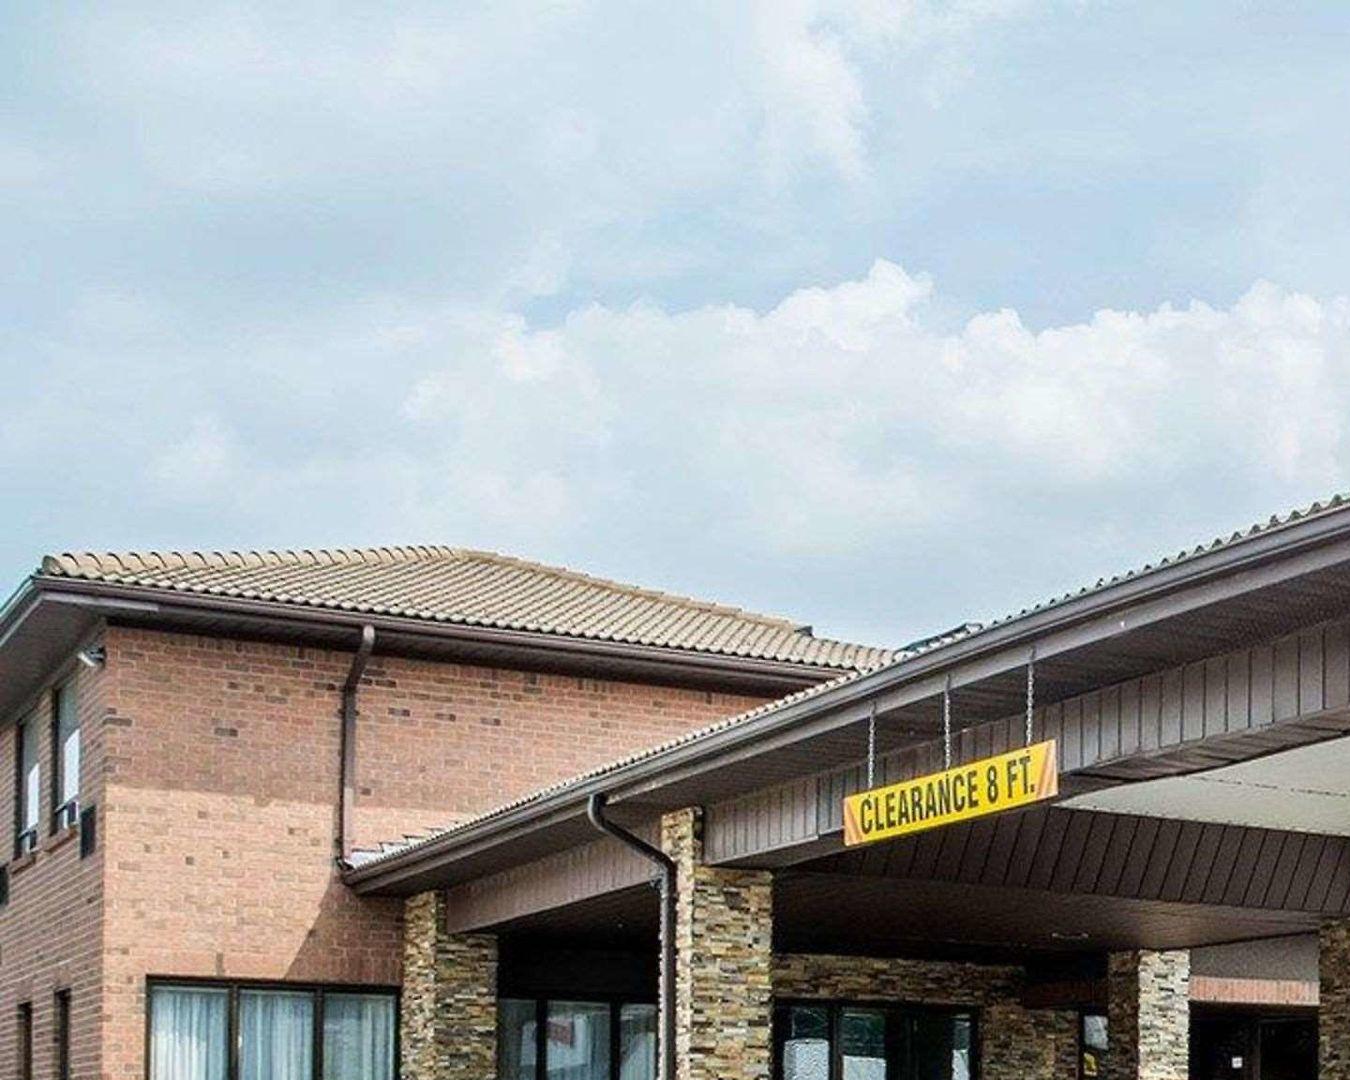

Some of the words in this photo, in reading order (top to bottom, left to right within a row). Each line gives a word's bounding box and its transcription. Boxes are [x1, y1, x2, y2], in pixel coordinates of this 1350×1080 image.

[860, 770, 978, 835] CLEARANCE
[987, 765, 999, 804] 8
[1006, 755, 1036, 799] FT.
